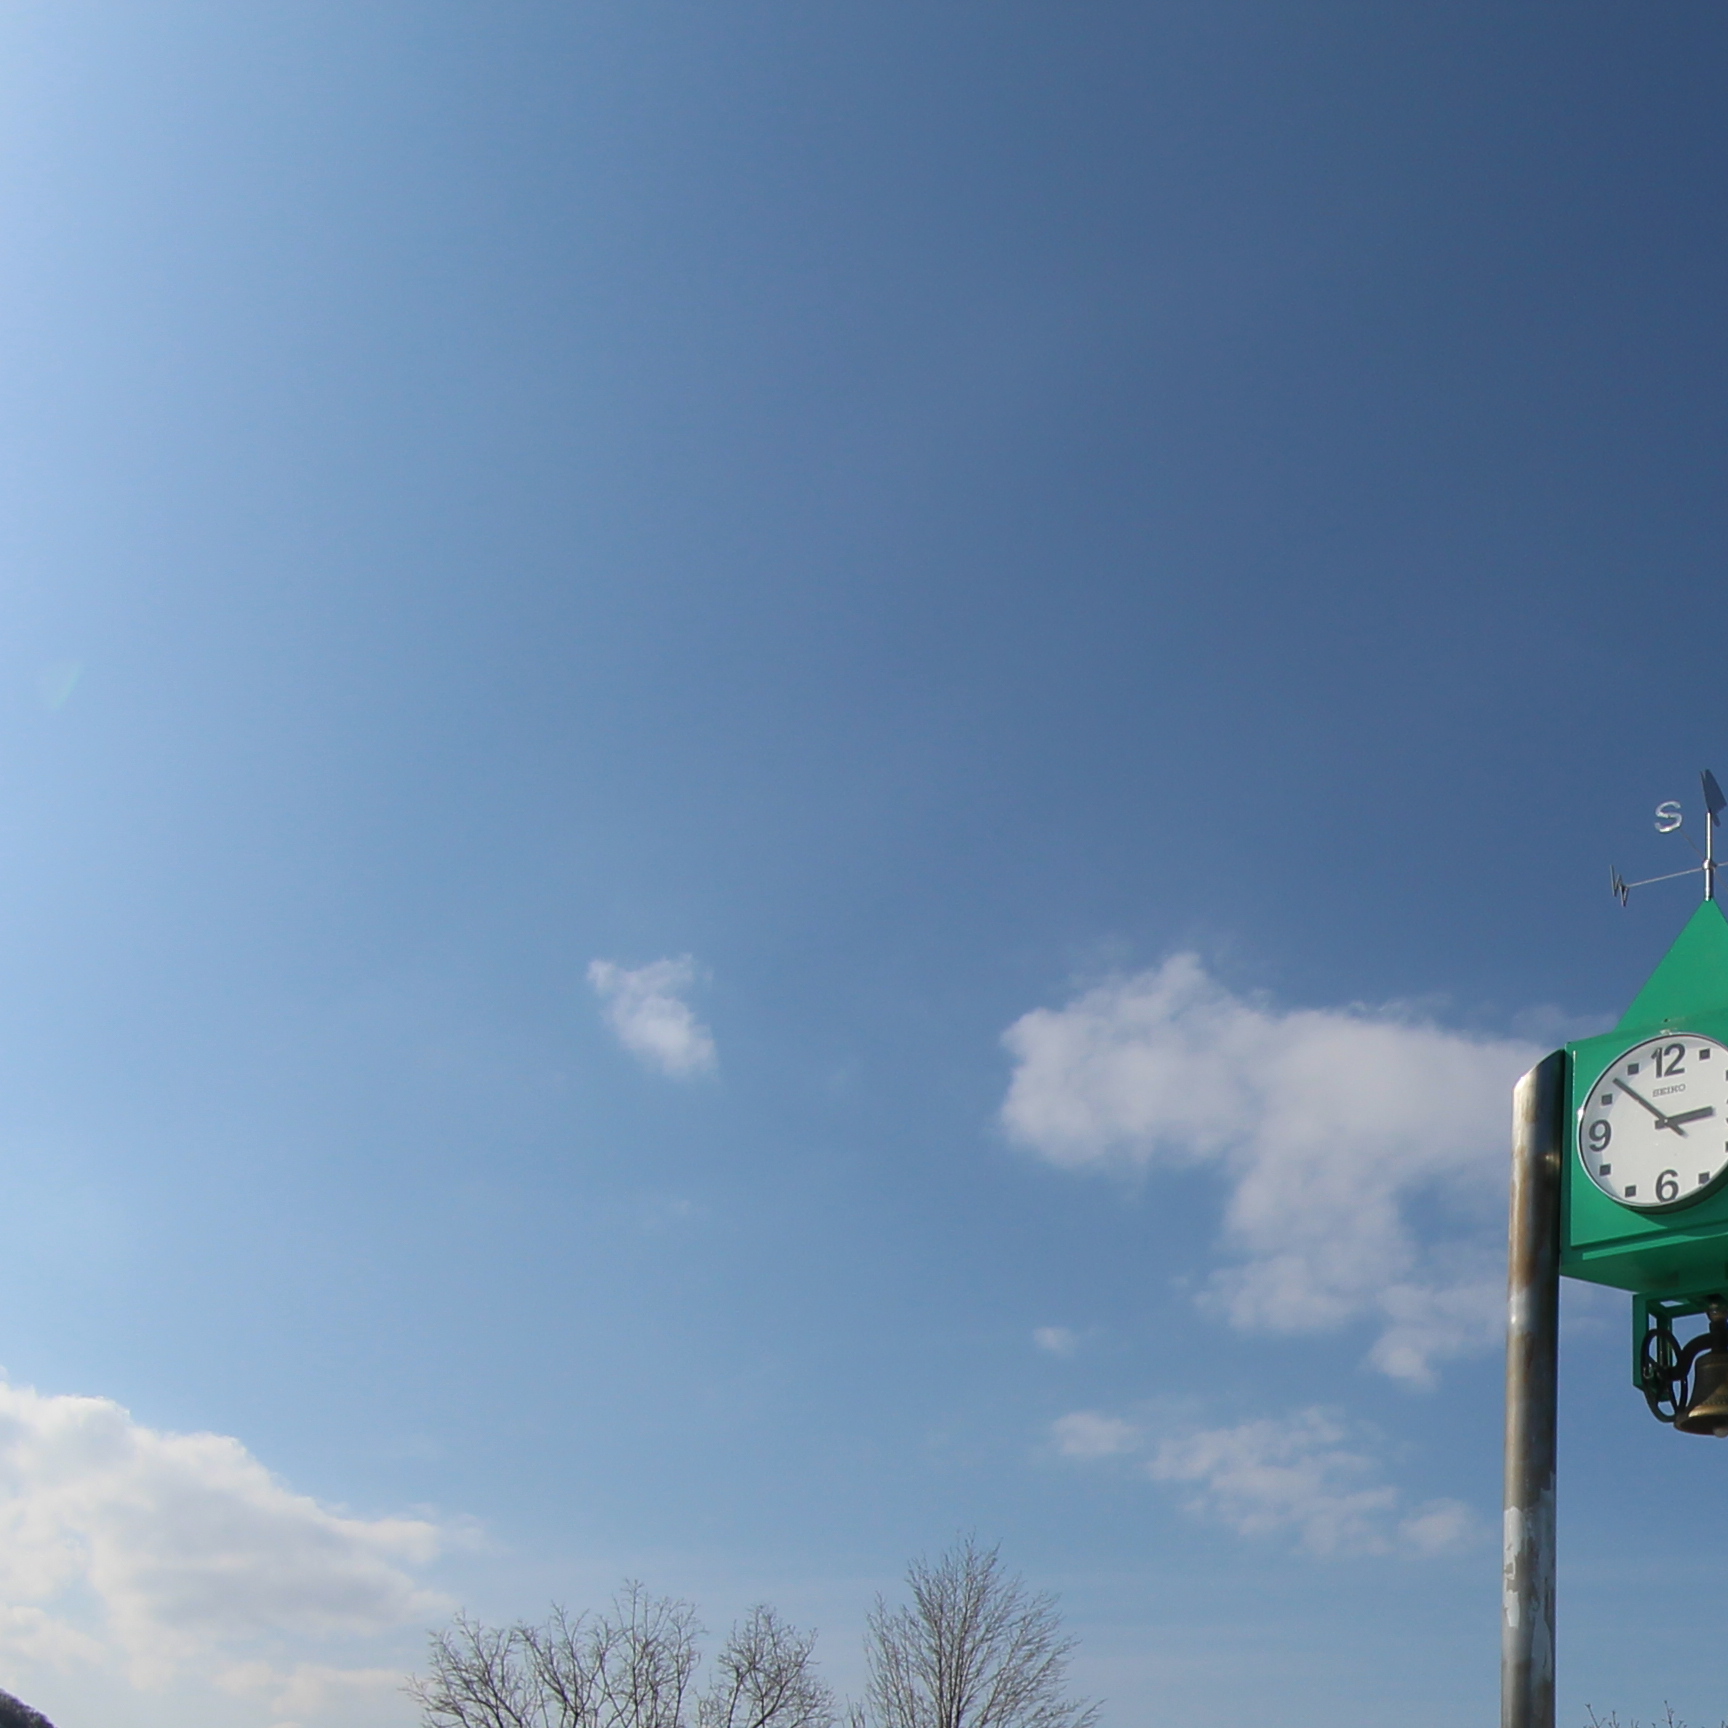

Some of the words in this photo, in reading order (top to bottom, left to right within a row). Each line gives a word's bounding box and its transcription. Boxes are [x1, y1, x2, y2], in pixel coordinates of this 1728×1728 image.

[1655, 801, 1683, 832] S
[1651, 1043, 1686, 1078] 12
[1652, 1083, 1686, 1098] SEIKO
[1588, 1119, 1612, 1152] 9
[1655, 1169, 1679, 1203] 6
